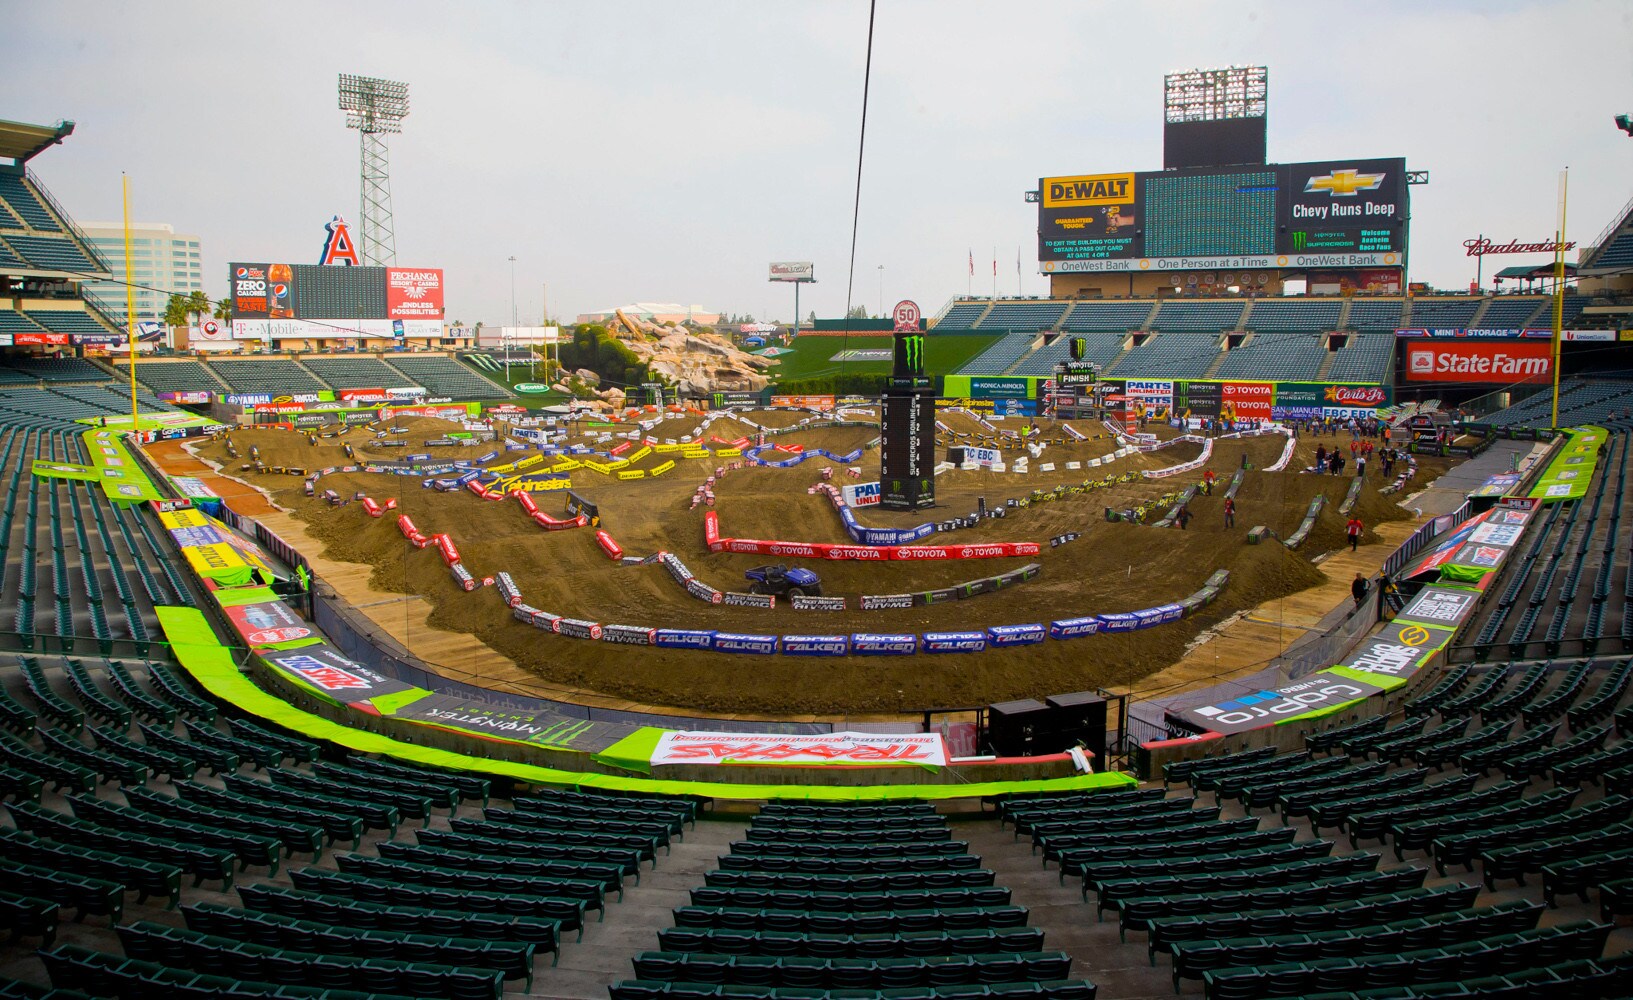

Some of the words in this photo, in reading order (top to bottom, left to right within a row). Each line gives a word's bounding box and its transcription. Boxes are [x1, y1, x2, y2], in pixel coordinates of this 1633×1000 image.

[1293, 204, 1329, 220] Chevy
[1331, 203, 1362, 217] Runs
[1365, 201, 1395, 217] Deep
[1055, 217, 1093, 225] GUARANTEED
[1463, 238, 1576, 257] Budweiser
[1157, 259, 1179, 269] One
[1181, 258, 1217, 268] Person
[1219, 259, 1229, 267] at
[1239, 257, 1268, 267] Time
[1296, 256, 1346, 266] OneWest
[1348, 254, 1377, 264] Bank
[1061, 261, 1103, 271] OneWest
[1105, 260, 1130, 270] Bank
[391, 271, 439, 281] PECHANGA
[236, 280, 267, 291] ZERO
[899, 309, 915, 321] 50
[260, 322, 299, 335] Mobile
[332, 325, 356, 334] Largest
[1436, 352, 1490, 373] State
[1491, 353, 1549, 374] Farm
[1127, 381, 1171, 389] PARTS
[1236, 386, 1271, 394] TOYOTA
[238, 395, 270, 404] YAMAHA
[1236, 401, 1270, 409] TOYOTA
[1292, 407, 1323, 415] MANUEL
[1324, 409, 1348, 417] EBC
[1351, 409, 1375, 418] EBC
[882, 422, 887, 430] 2
[916, 423, 920, 431] 2
[514, 429, 538, 438] PARTS
[882, 437, 887, 445] 3
[916, 438, 920, 446] 3
[882, 452, 887, 460] 4
[916, 453, 920, 461] 4
[978, 450, 993, 461] EBC
[916, 468, 920, 476] 5
[508, 479, 572, 491] alpinestars
[1510, 500, 1531, 508] MLB
[781, 546, 814, 555] TOYOTA
[843, 549, 880, 558] TOYOTA
[912, 549, 947, 558] TOYOTA
[974, 547, 1004, 556] TOYOTA
[1163, 609, 1183, 619] FALKEN
[1107, 620, 1138, 629] FALKEN
[1141, 614, 1163, 625] FALKEN
[1062, 623, 1098, 635] FALKEN
[658, 635, 711, 645] FALKEN
[996, 632, 1045, 643] FALKEN
[716, 639, 772, 650] FALKEN
[785, 643, 844, 652] FALKEN
[855, 643, 915, 651] FALKEN
[928, 640, 985, 651] FALKEN
[1348, 643, 1393, 673] OPTICS
[1375, 645, 1420, 674] SMITH
[1215, 684, 1362, 725] GoPro
[455, 707, 535, 722] ENERGY
[426, 708, 541, 734] MONSTER
[669, 743, 934, 760] TRAXXAS
